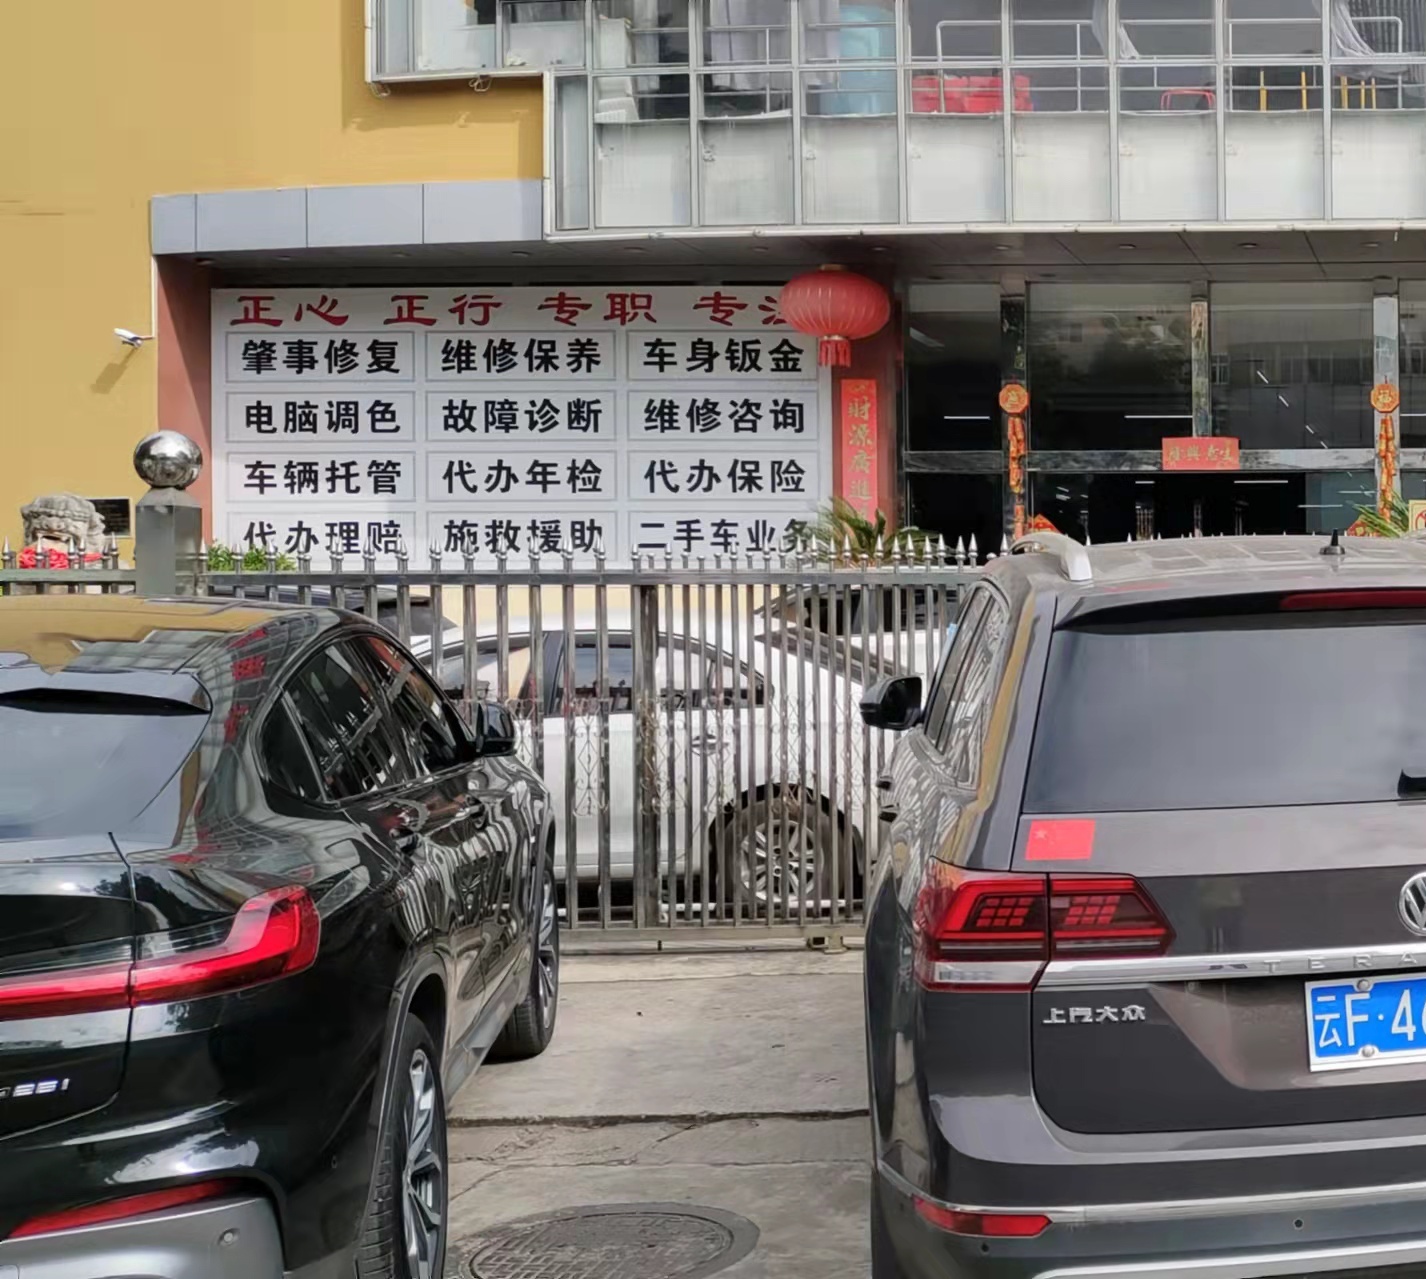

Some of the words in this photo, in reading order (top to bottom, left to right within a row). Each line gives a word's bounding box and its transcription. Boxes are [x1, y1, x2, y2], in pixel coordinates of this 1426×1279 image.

[230, 294, 349, 327] 正心
[383, 294, 503, 326] 正行
[537, 291, 657, 326] 专职
[241, 338, 401, 375] 肇事修复
[441, 337, 602, 374] 维修保养
[643, 337, 804, 373] 车身钣金
[245, 399, 401, 434] 电脑调色
[442, 398, 603, 434] 故障诊断
[644, 397, 805, 434] 维修咨询
[244, 459, 402, 495] 车辆托管
[443, 458, 603, 494] 代办年检
[644, 458, 806, 493] 代办保险
[243, 519, 402, 554] 代办理赔
[443, 518, 604, 554] 施救援助
[1042, 1004, 1146, 1024] 上汽大众
